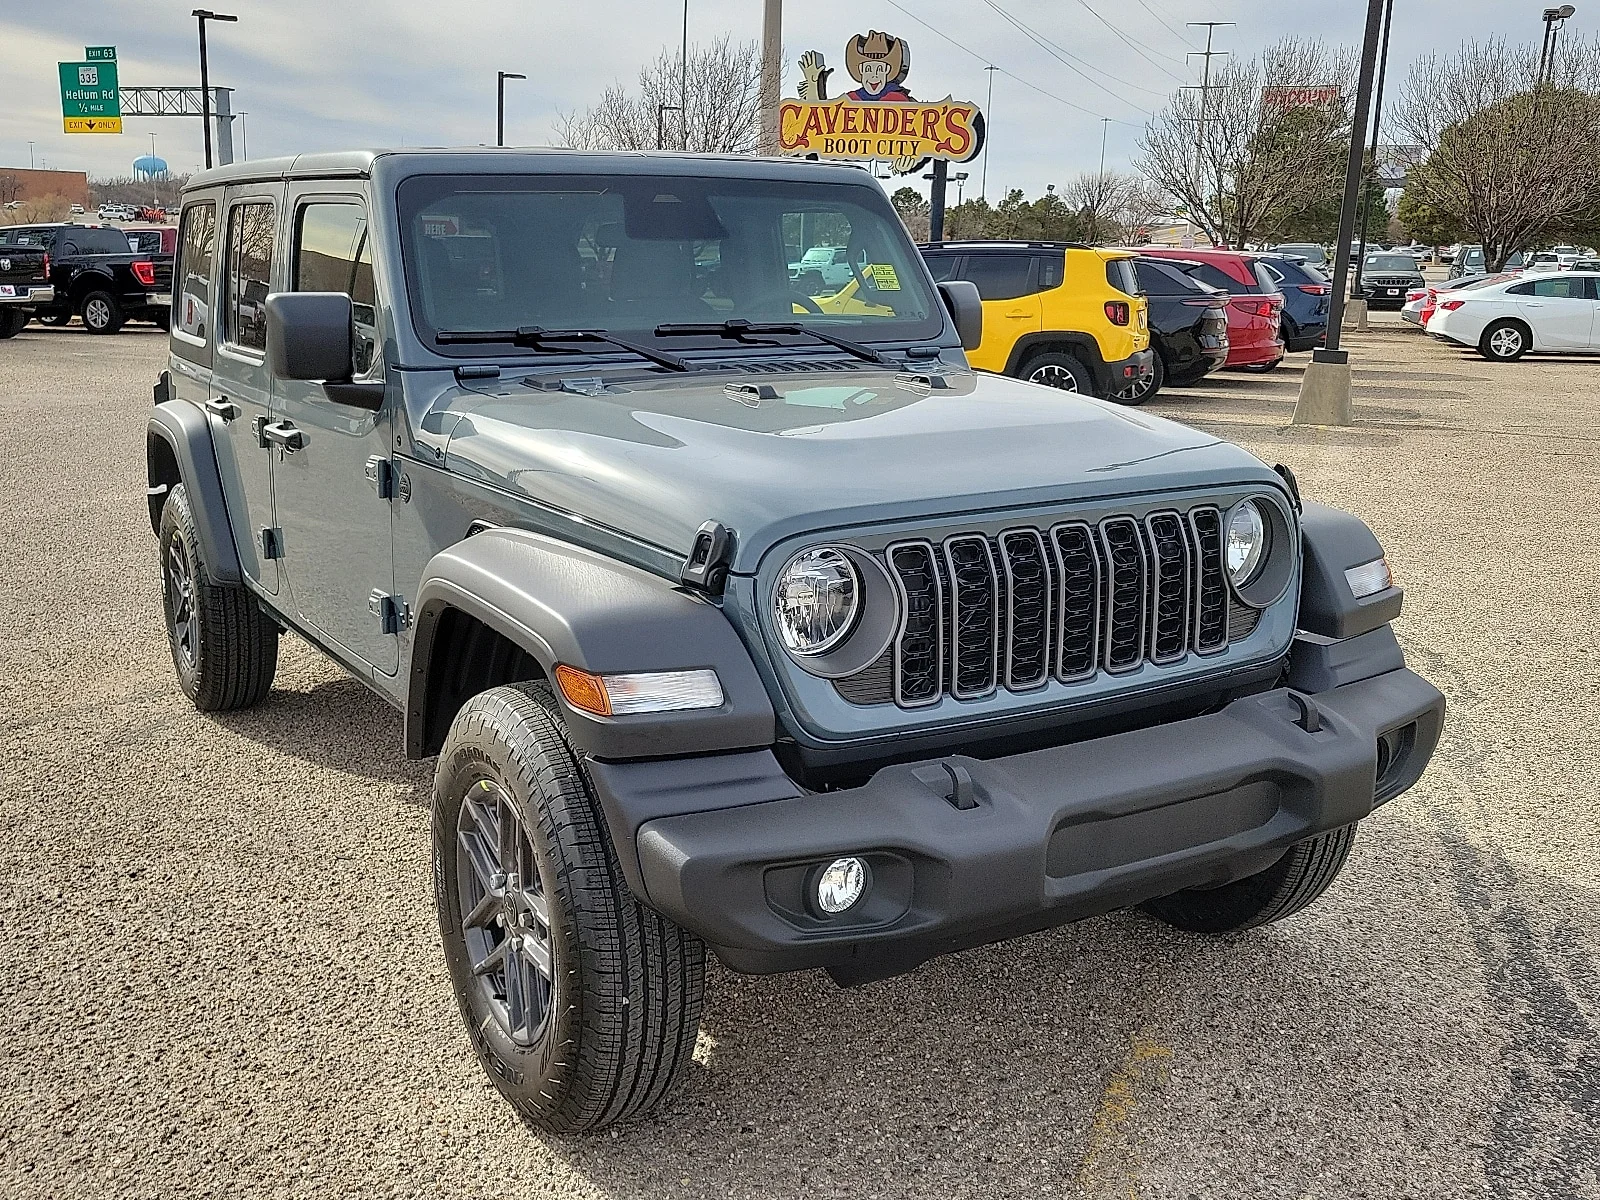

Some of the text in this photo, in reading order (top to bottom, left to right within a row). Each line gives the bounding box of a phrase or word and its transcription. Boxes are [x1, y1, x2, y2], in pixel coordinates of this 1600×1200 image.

[103, 48, 114, 58] 63
[80, 73, 97, 83] 335
[65, 89, 114, 100] Helium Rd
[69, 121, 116, 129] EXIT ONLY
[779, 101, 971, 154] CAVENDER'S
[823, 137, 922, 155] BOOT CITY
[425, 223, 447, 235] HERE
